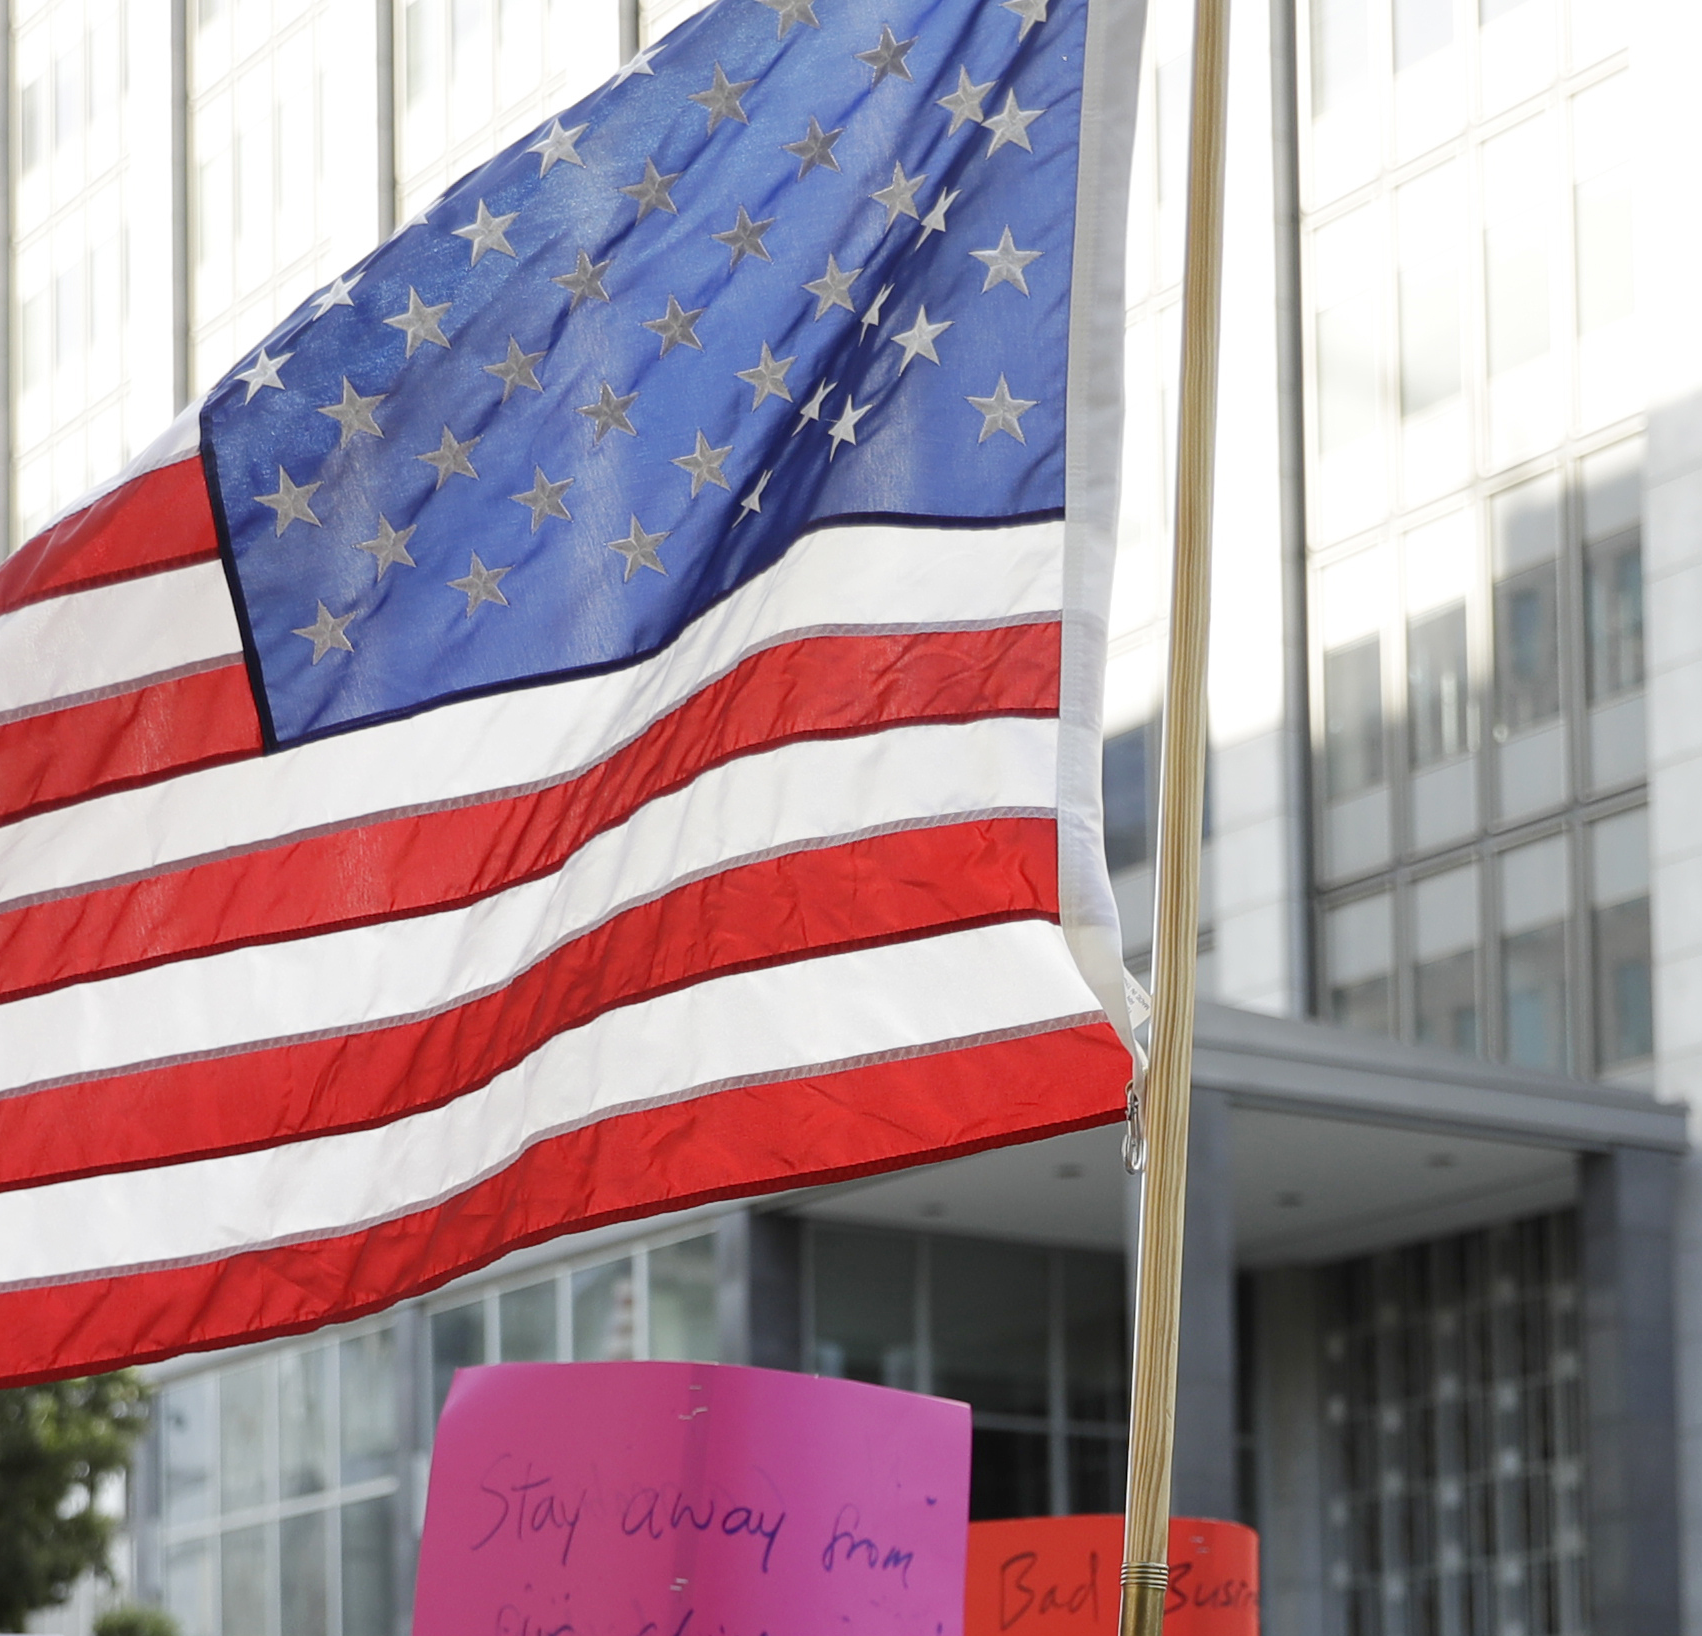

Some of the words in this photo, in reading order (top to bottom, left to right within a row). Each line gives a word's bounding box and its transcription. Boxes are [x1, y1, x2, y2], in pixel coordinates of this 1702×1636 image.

[471, 1453, 588, 1567] Stay
[620, 1485, 786, 1573] away
[821, 1504, 914, 1589] from
[1000, 1551, 1098, 1633] Bad
